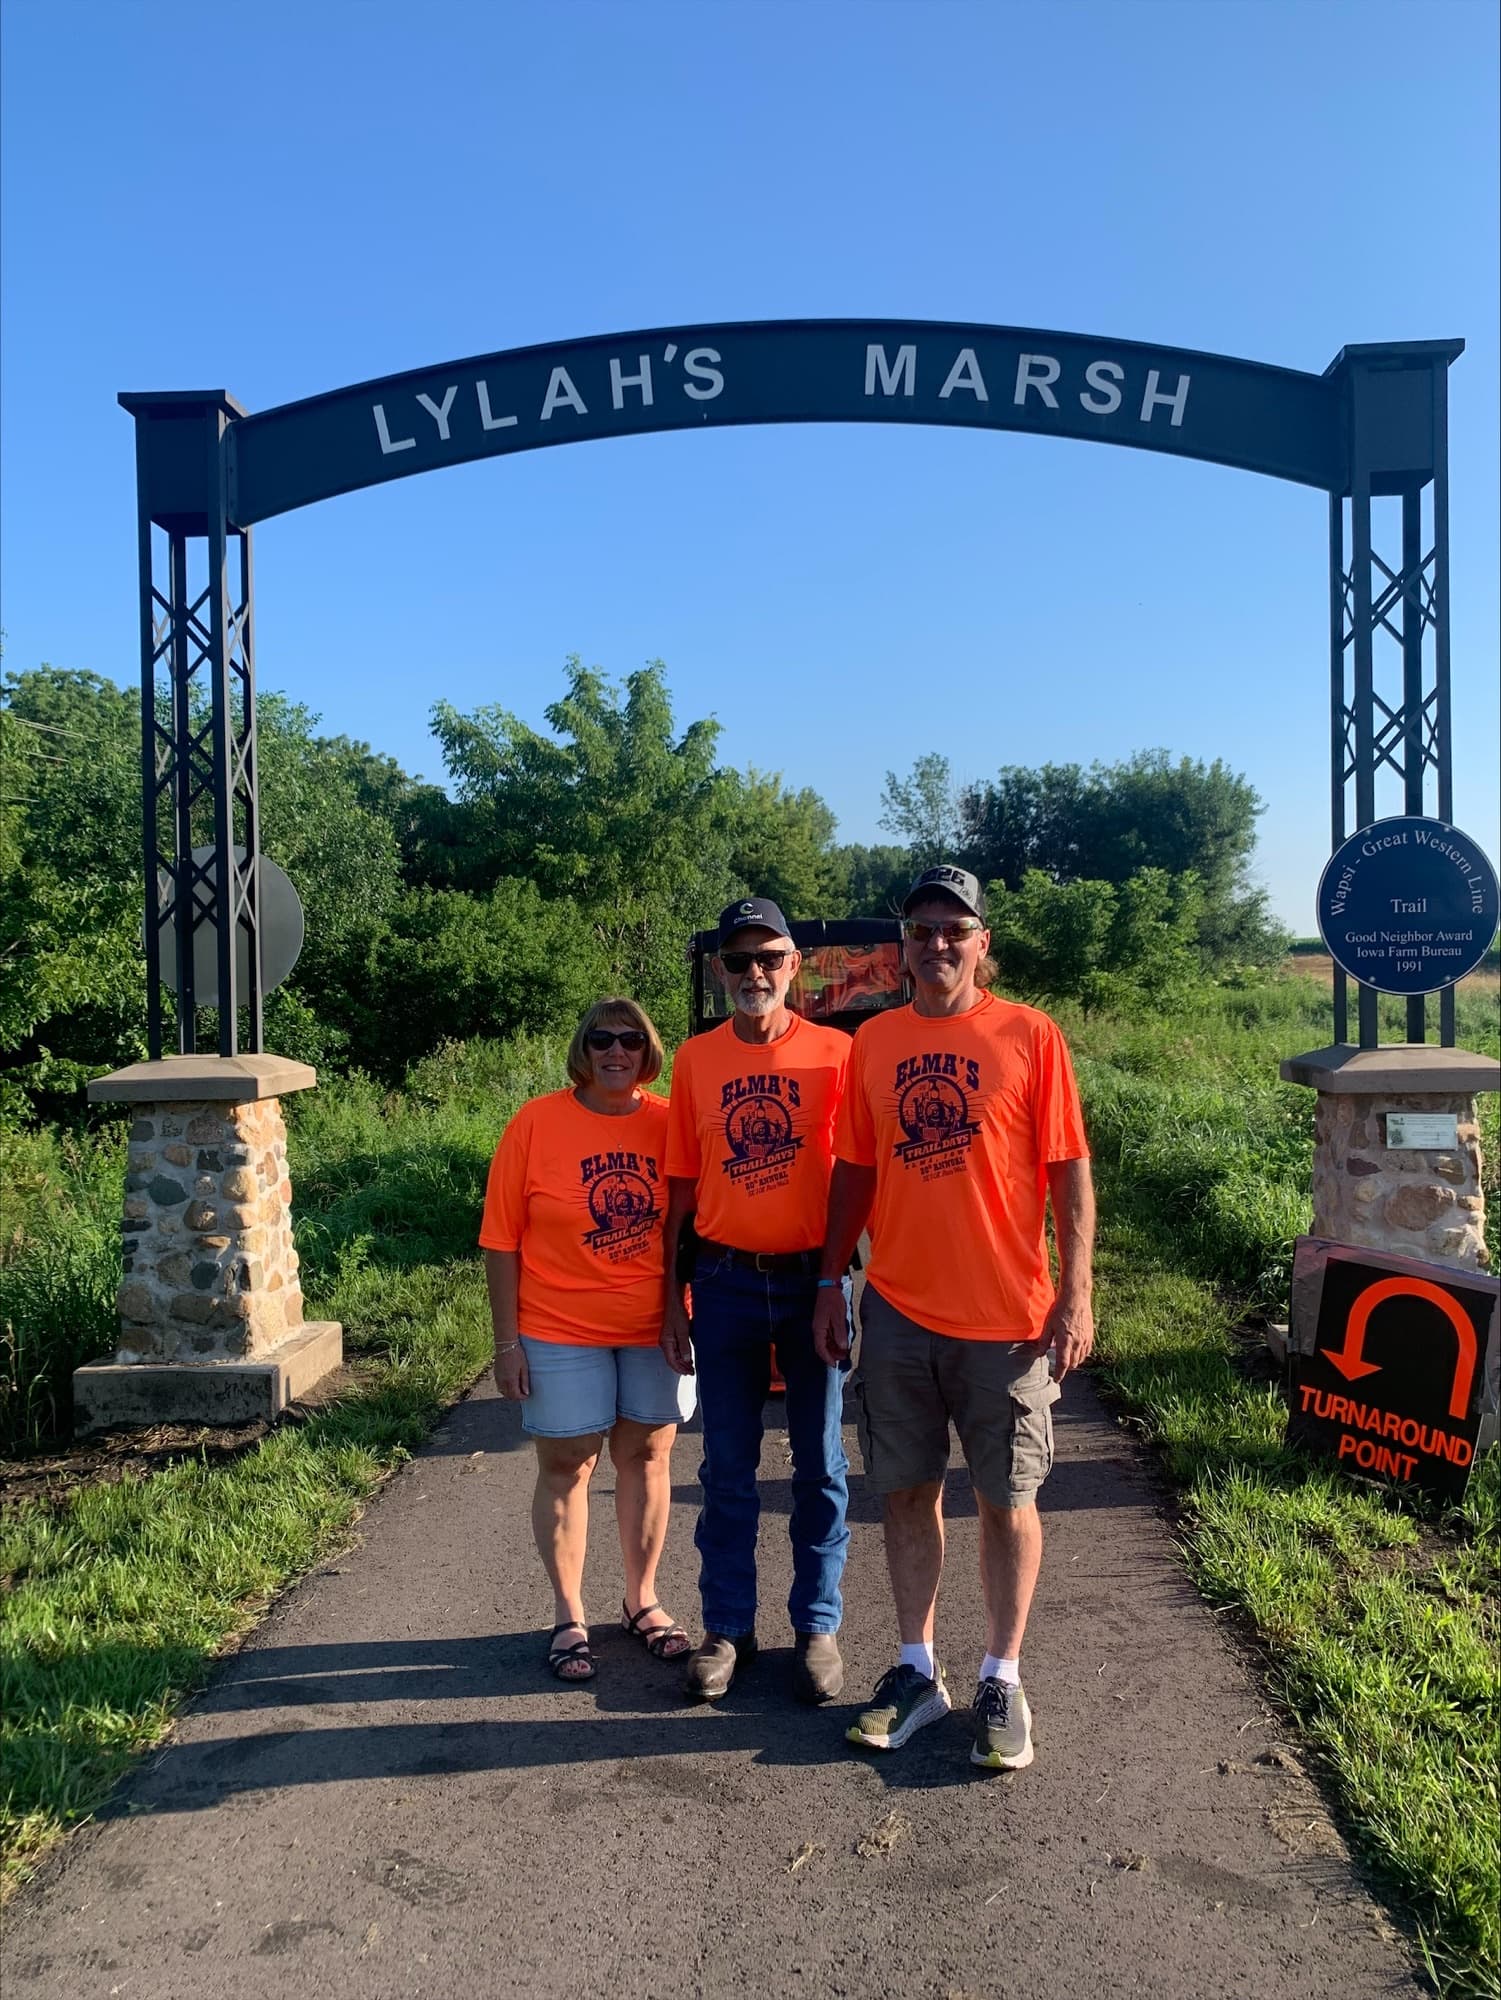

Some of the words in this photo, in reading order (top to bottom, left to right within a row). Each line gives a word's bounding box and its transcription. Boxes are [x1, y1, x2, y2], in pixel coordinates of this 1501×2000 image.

[373, 343, 725, 453] LYLAH'S
[865, 344, 1191, 426] MARSH
[1331, 864, 1356, 916] Wapsi
[1362, 831, 1408, 857] Great
[1415, 829, 1472, 874] Western
[1468, 876, 1486, 914] Line
[1390, 898, 1427, 913] Trail
[1345, 931, 1377, 943] Good
[1380, 930, 1433, 945] Neighbor
[1436, 930, 1473, 942] Award
[1357, 947, 1385, 958] Iowa
[1388, 946, 1418, 957] Farm
[1421, 945, 1463, 957] Bureau
[1396, 961, 1422, 972] 1991
[895, 1053, 979, 1092] ELMA'S
[721, 1074, 800, 1110] ELMA'S
[906, 1143, 941, 1159] TRAIL
[942, 1133, 969, 1149] DAYS
[580, 1152, 659, 1184] ELMA'S
[731, 1158, 766, 1174] TRAIL
[767, 1148, 793, 1164] DAYS
[595, 1229, 629, 1246] TRAIL
[1300, 1385, 1473, 1466] TURNAROUND
[1338, 1434, 1419, 1481] POINT
